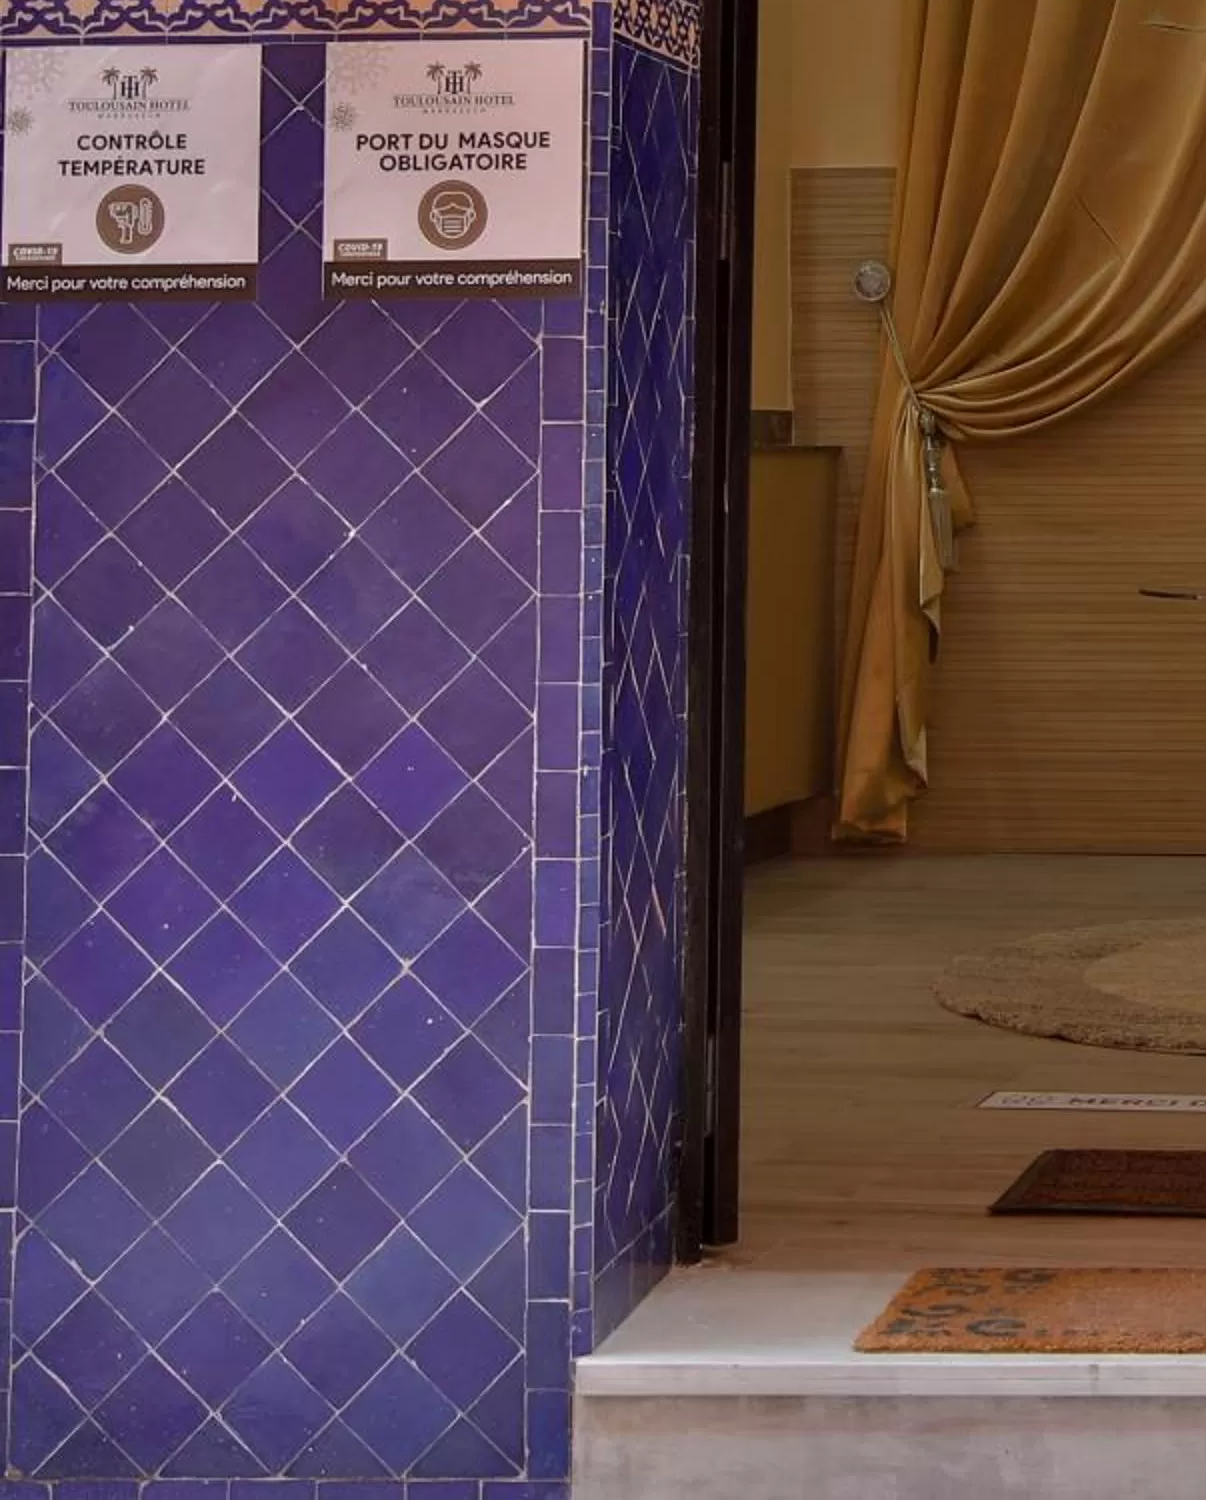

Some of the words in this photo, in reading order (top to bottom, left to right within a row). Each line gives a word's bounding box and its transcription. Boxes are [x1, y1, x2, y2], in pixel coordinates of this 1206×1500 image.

[474, 95, 515, 106] HOTEL
[77, 130, 187, 151] CONTRÔLE
[356, 134, 413, 151] PORT
[419, 133, 448, 150] DU
[459, 131, 550, 149] MASQUE
[58, 157, 206, 176] TEMPÉRATURE
[379, 154, 527, 171] OBLIGATOIRE
[7, 277, 49, 290] Merci
[51, 279, 86, 293] pour
[89, 278, 128, 290] votre
[131, 274, 246, 291] compréhension
[331, 272, 373, 286] Merci
[377, 274, 411, 289] pour
[415, 273, 453, 286] votre
[457, 269, 572, 287] compréhension
[1069, 1096, 1179, 1106] MERCI
